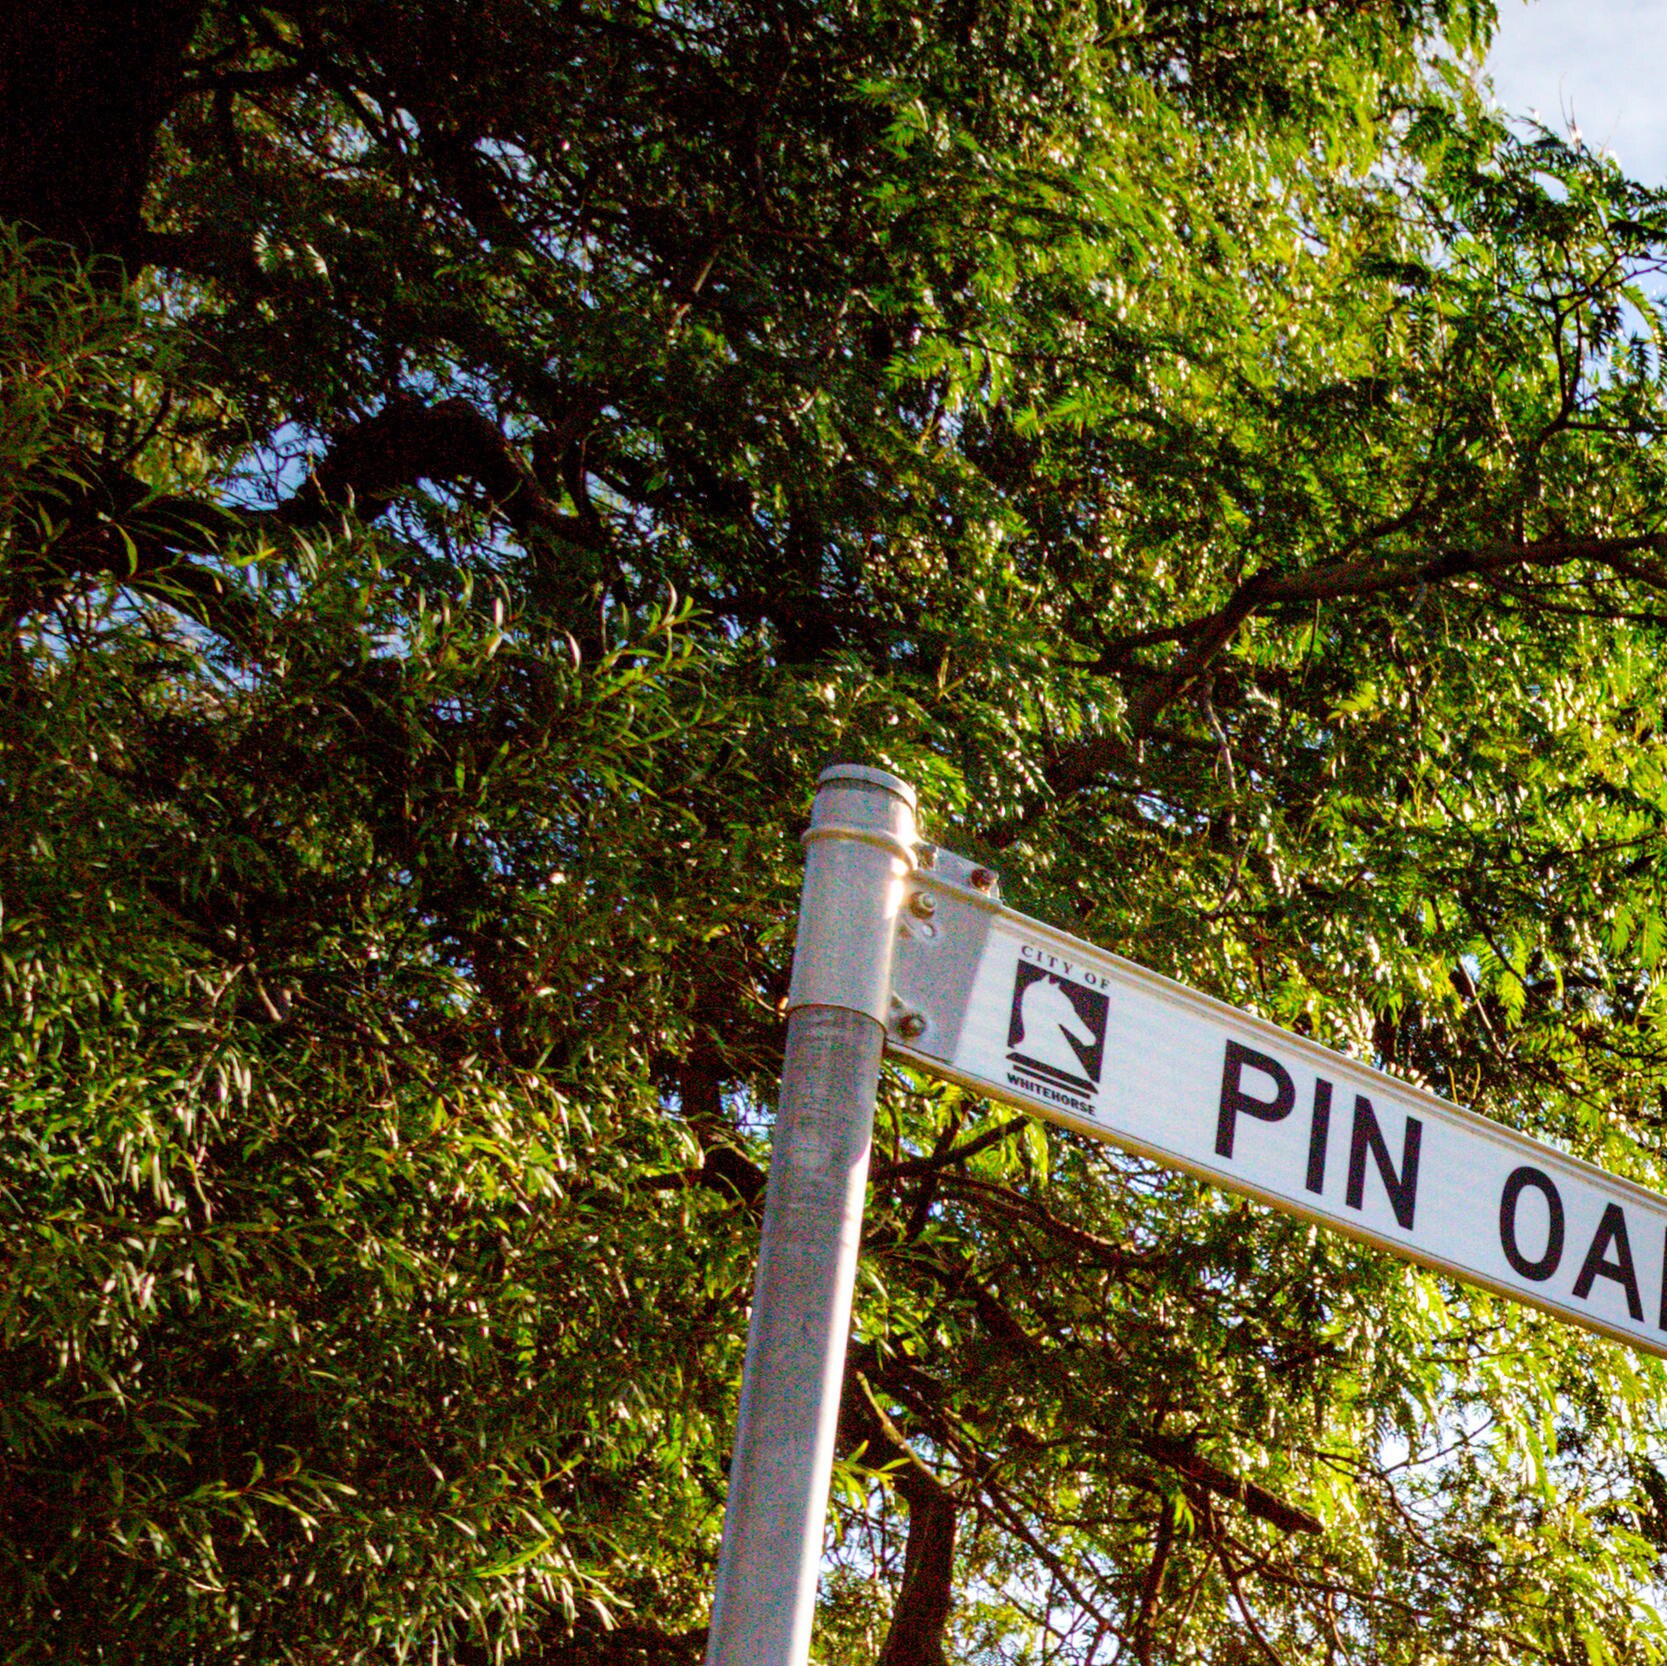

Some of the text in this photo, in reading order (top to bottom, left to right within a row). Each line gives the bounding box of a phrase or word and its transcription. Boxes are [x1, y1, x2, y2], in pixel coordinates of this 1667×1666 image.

[1021, 946, 1110, 989] CITY OF
[1006, 1073, 1096, 1116] WHITEHORSE
[1215, 1040, 1423, 1230] PIN
